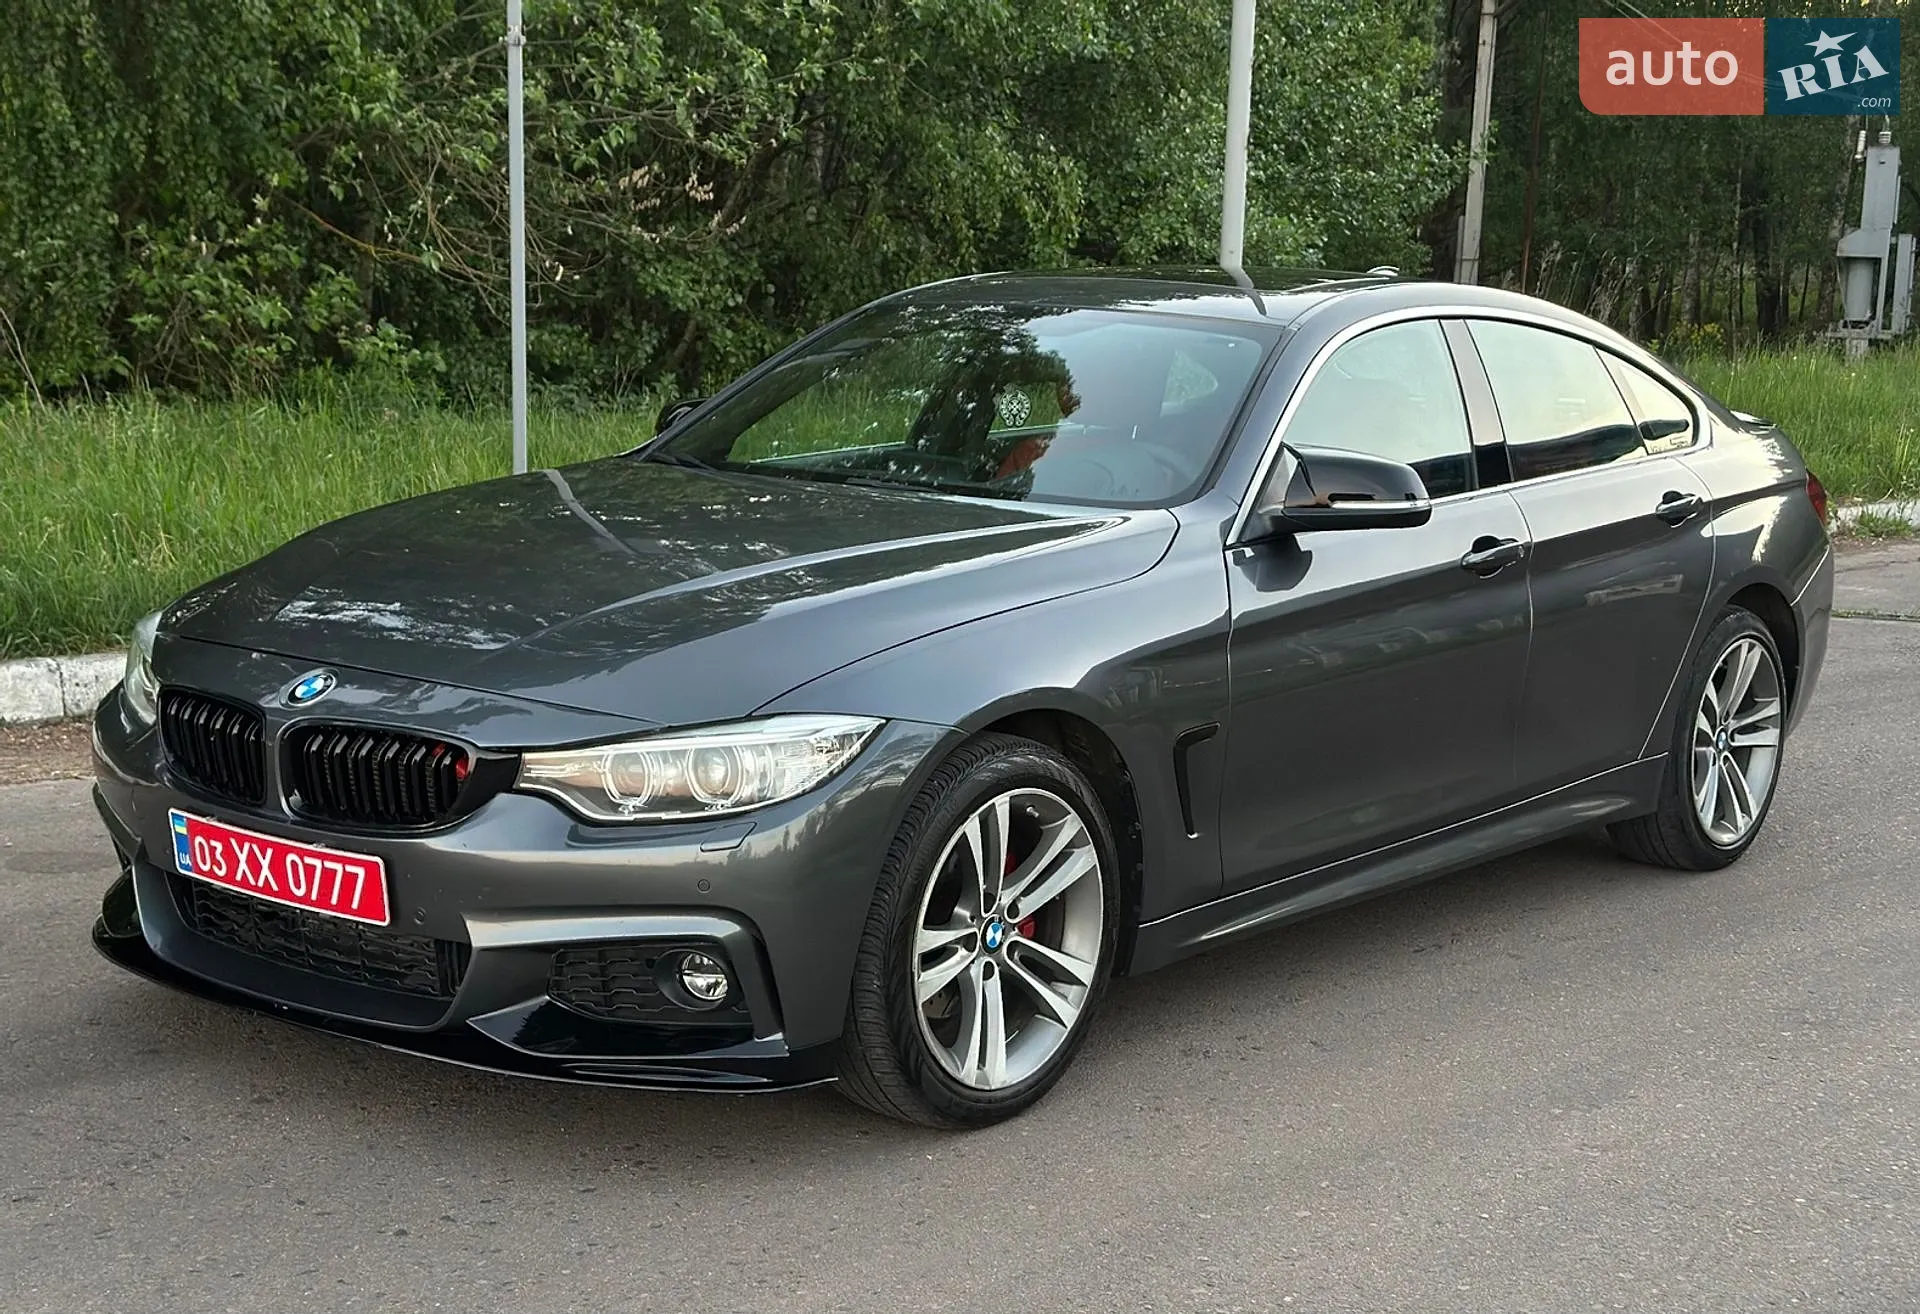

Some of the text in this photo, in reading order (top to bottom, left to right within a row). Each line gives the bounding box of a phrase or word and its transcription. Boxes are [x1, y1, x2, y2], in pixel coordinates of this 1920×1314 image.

[194, 835, 366, 909] 03 XX 0777
